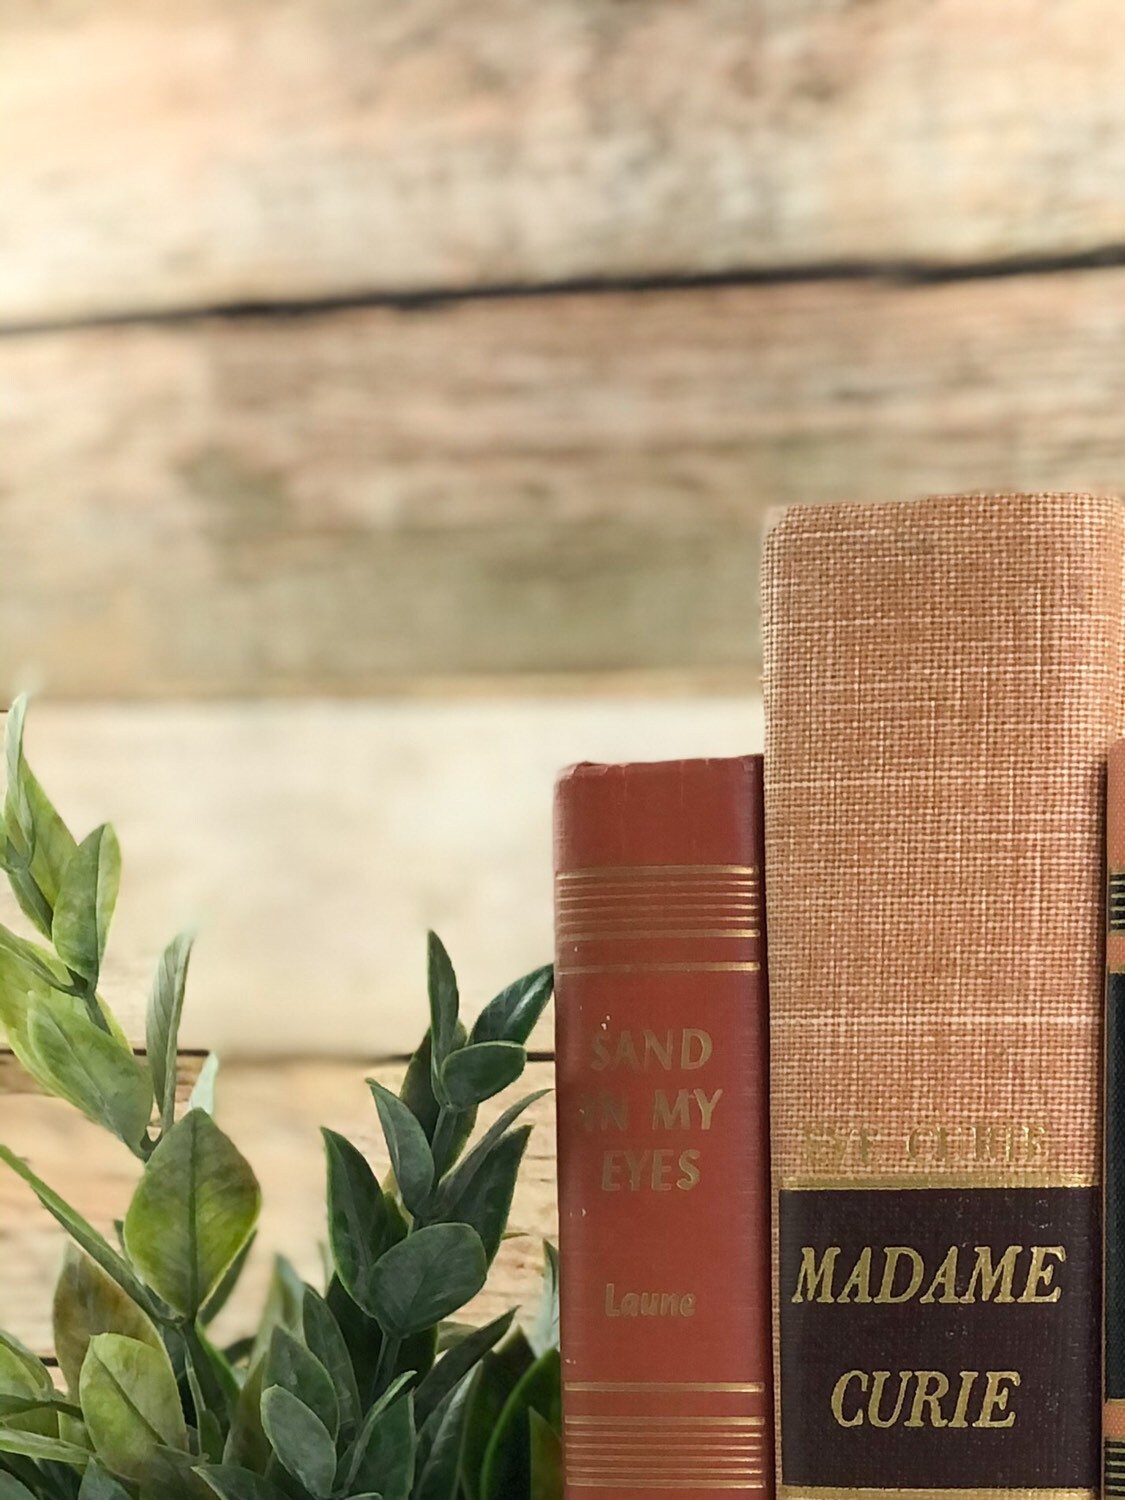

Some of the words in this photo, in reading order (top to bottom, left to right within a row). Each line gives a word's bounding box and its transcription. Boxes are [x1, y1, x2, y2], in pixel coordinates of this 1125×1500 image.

[590, 1028, 713, 1071] SAND
[578, 1090, 630, 1132] IN
[651, 1088, 724, 1131] MY
[600, 1148, 701, 1192] EYES
[790, 1245, 1067, 1304] MADAME
[604, 1282, 698, 1318] Laune
[829, 1370, 1021, 1429] CURIE
